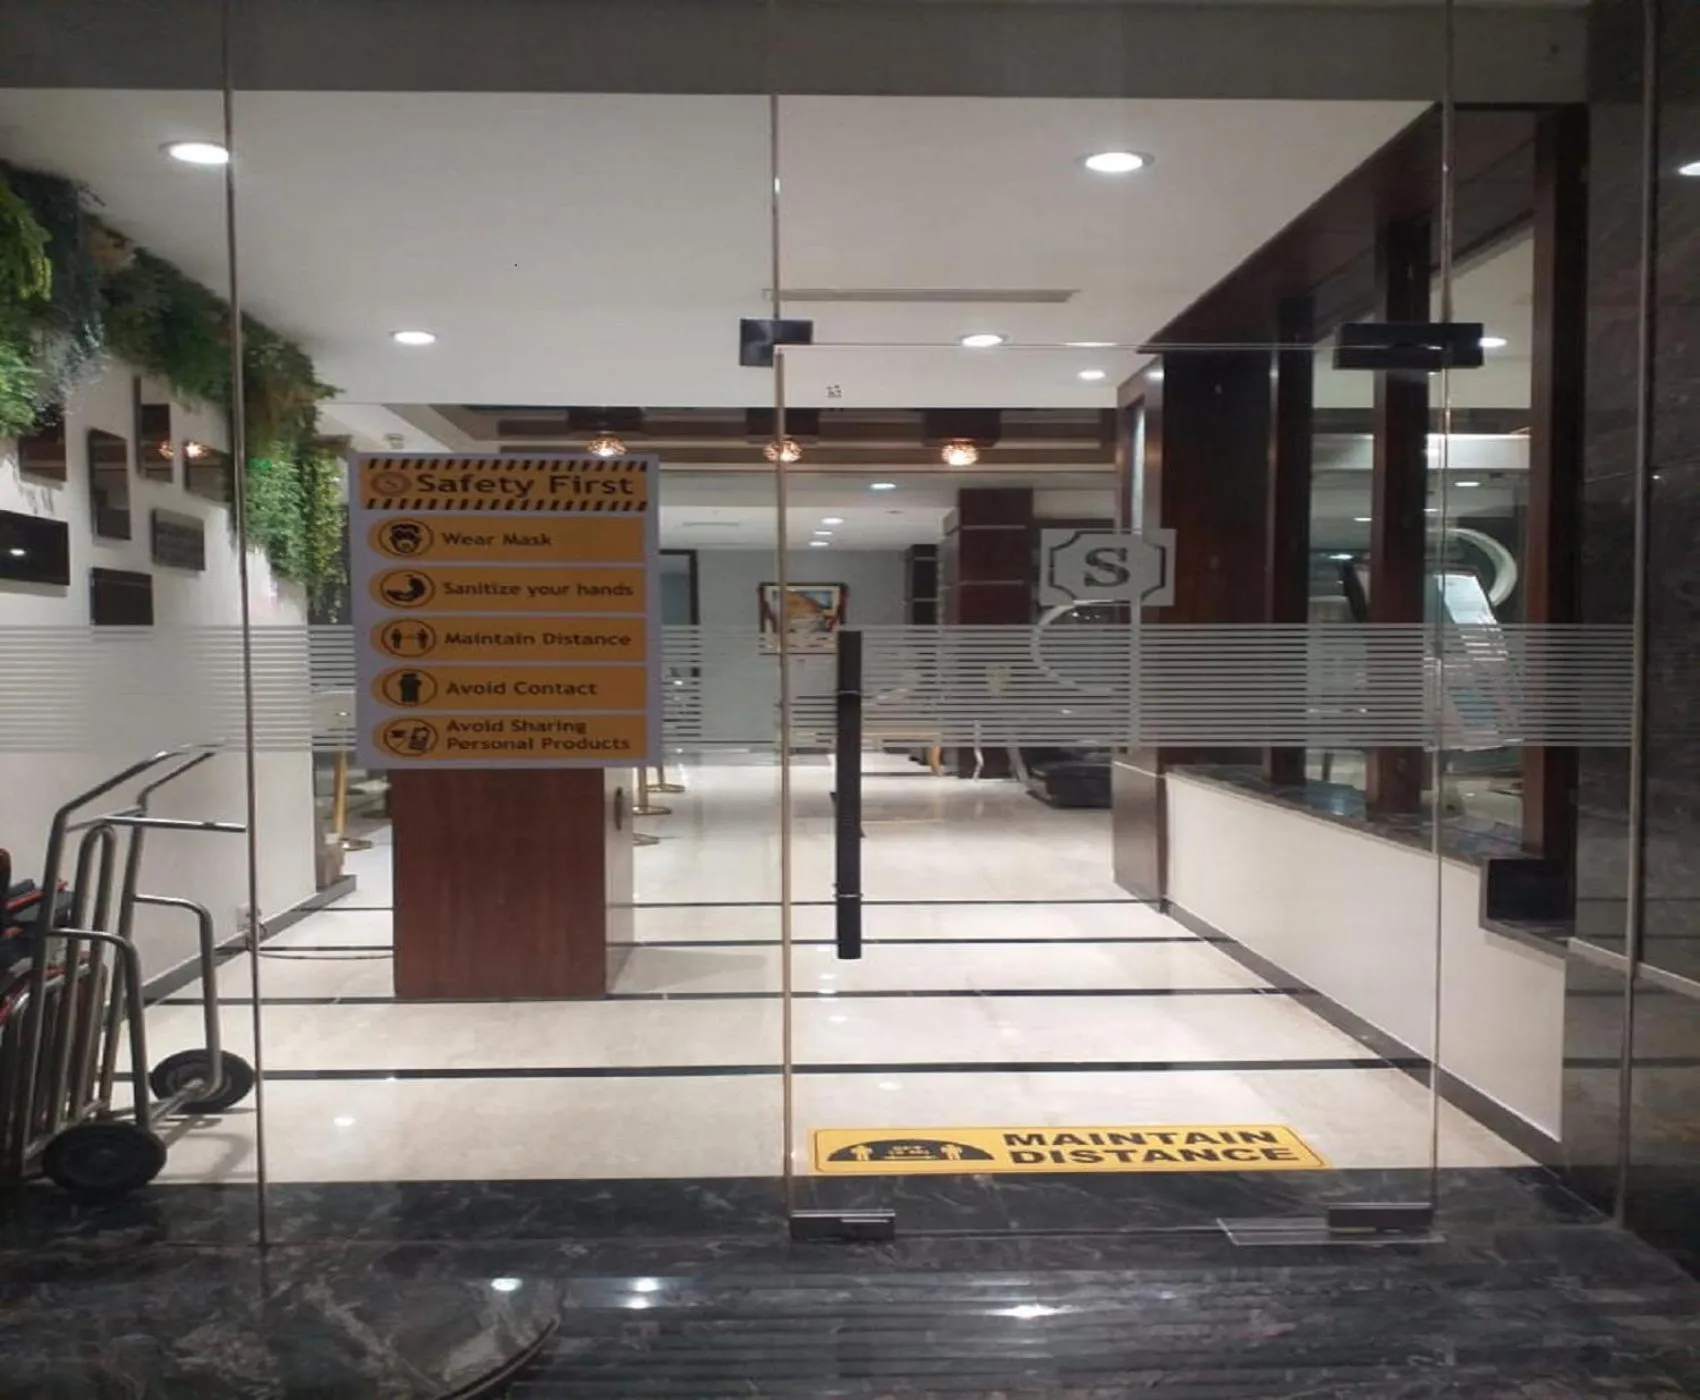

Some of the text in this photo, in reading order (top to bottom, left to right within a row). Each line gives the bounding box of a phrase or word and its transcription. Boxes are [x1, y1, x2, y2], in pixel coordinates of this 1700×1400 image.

[417, 474, 634, 497] Safety First
[442, 532, 552, 546] Wear Mask
[1084, 547, 1131, 587] S
[442, 582, 633, 598] Sanitize your hands
[444, 633, 631, 646] Maintain Distance
[446, 681, 597, 695] Avoid Contact
[446, 719, 587, 734] Avoid Sharing
[446, 737, 630, 750] Personal Products
[1003, 1131, 1278, 1146] MAINTAIN
[1010, 1148, 1299, 1163] DISTANCE
